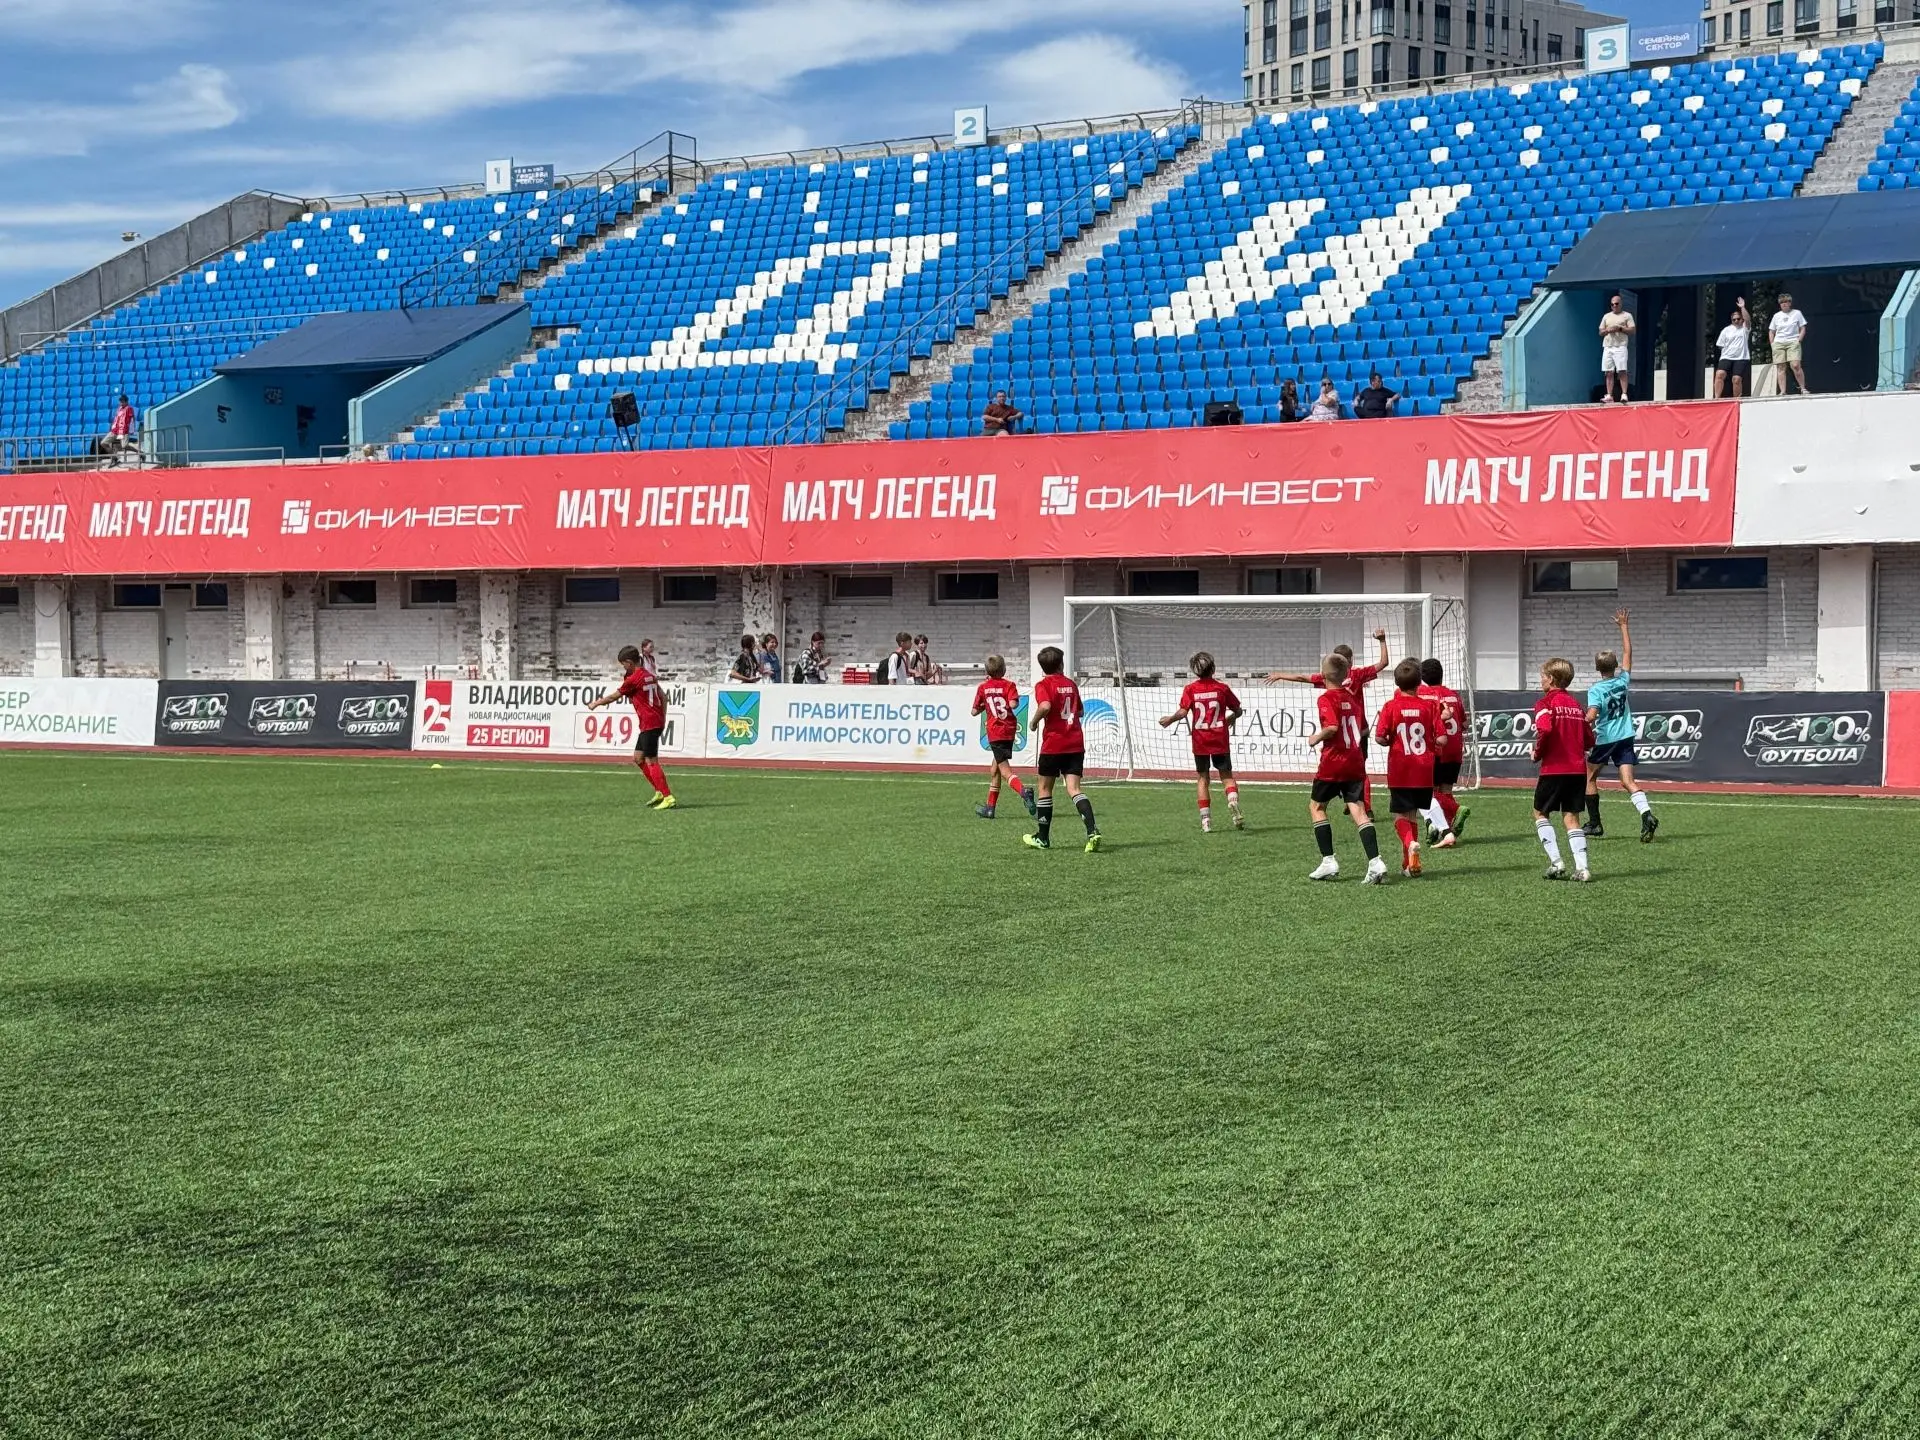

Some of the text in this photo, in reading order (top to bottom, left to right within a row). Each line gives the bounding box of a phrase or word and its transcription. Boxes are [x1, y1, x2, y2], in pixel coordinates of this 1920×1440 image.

[1598, 38, 1618, 60] 3
[1638, 32, 1690, 46] СЕМЕЙНЫЙ
[1646, 41, 1682, 52] СЕКТОР
[962, 116, 977, 136] 2
[494, 167, 501, 184] 1
[1424, 448, 1711, 506] МАТЧ ЛЕГЕНД
[782, 474, 997, 522] МАТЧ ЛЕГЕНД
[1085, 475, 1379, 511] ФИНИНВЕСТ
[315, 503, 523, 530] ФИНИНВЕСТ
[556, 484, 750, 529] МАТЧ ЛЕГЕНД
[88, 497, 251, 539] МАТЧ ЛЕГЕНД
[189, 696, 228, 718] 100%
[277, 697, 317, 718] 100%
[367, 699, 409, 718] 100%
[423, 698, 451, 732] 25
[468, 711, 551, 722] НОВАЯ РАДИОСТАНЦИЯ
[788, 702, 950, 721] ПРАВИТЕЛЬСТВО
[986, 696, 1008, 720] 13
[1194, 701, 1224, 730] 22
[170, 719, 221, 732] ФУТБОЛА
[257, 721, 309, 733] ФУТБОЛА
[347, 721, 400, 734] ФУТБОЛА
[584, 715, 633, 746] 94,9
[771, 725, 966, 746] ПРИМОРСКОГО КРАЯ
[1341, 715, 1361, 749] 11
[1795, 715, 1871, 742] 100%
[421, 734, 450, 744] РЕГИОН
[472, 728, 546, 746] 25 РЕГИОН
[1396, 722, 1427, 756] 18
[1229, 742, 1318, 755] ЕРМИНА
[1761, 747, 1858, 762] ФУТБОЛА
